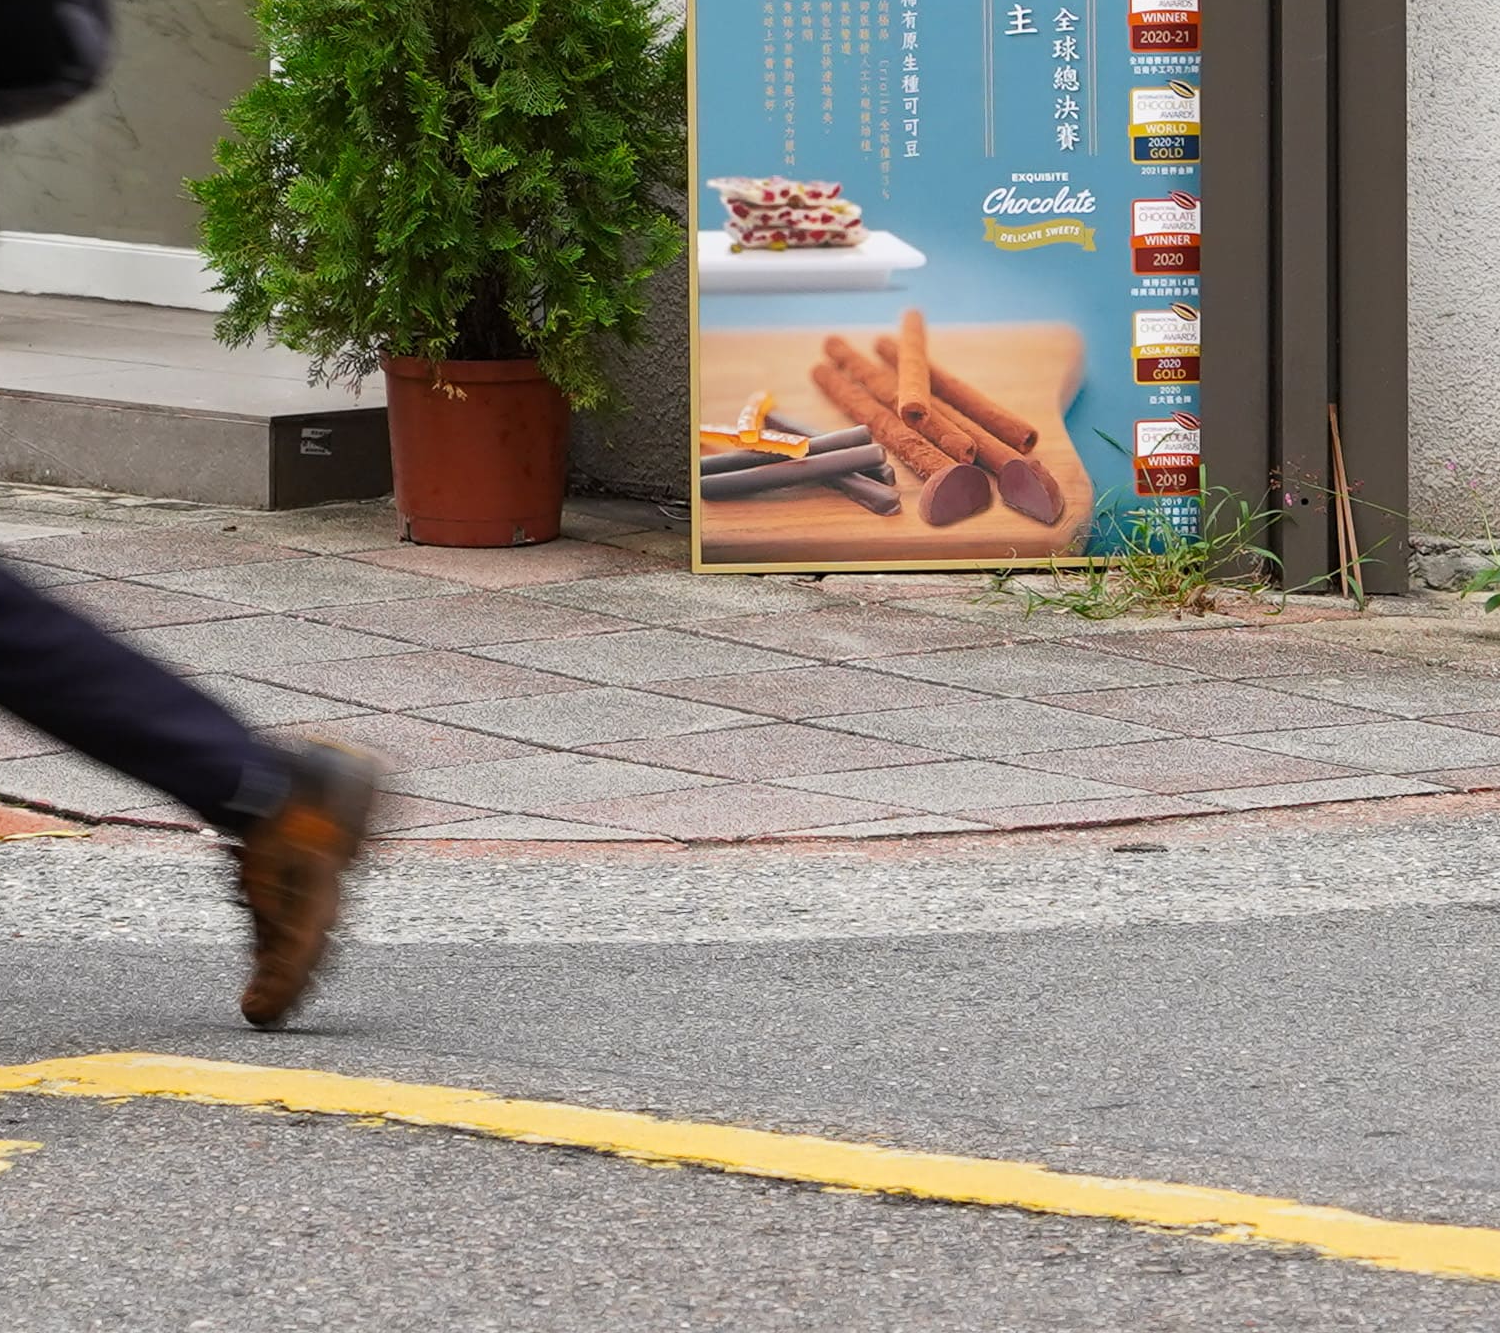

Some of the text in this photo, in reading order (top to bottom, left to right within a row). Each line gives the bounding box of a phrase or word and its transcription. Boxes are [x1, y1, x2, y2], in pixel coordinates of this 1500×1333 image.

[1141, 12, 1188, 23] WINNER
[1140, 31, 1189, 44] 2020-21
[1145, 123, 1187, 133] WORLD
[1148, 137, 1185, 147] 2020-21
[1150, 148, 1184, 158] GOLD
[1012, 172, 1069, 183] EXQUISITE
[982, 186, 1096, 214] Chocolate
[1000, 225, 1081, 243] DELICATE SWEETS
[1144, 234, 1191, 245] WINNER
[1153, 253, 1184, 266] 2020
[1158, 359, 1182, 368] 2020
[1153, 369, 1186, 379] GOLD
[1148, 456, 1194, 466] WINNER
[1156, 474, 1187, 486] 2019
